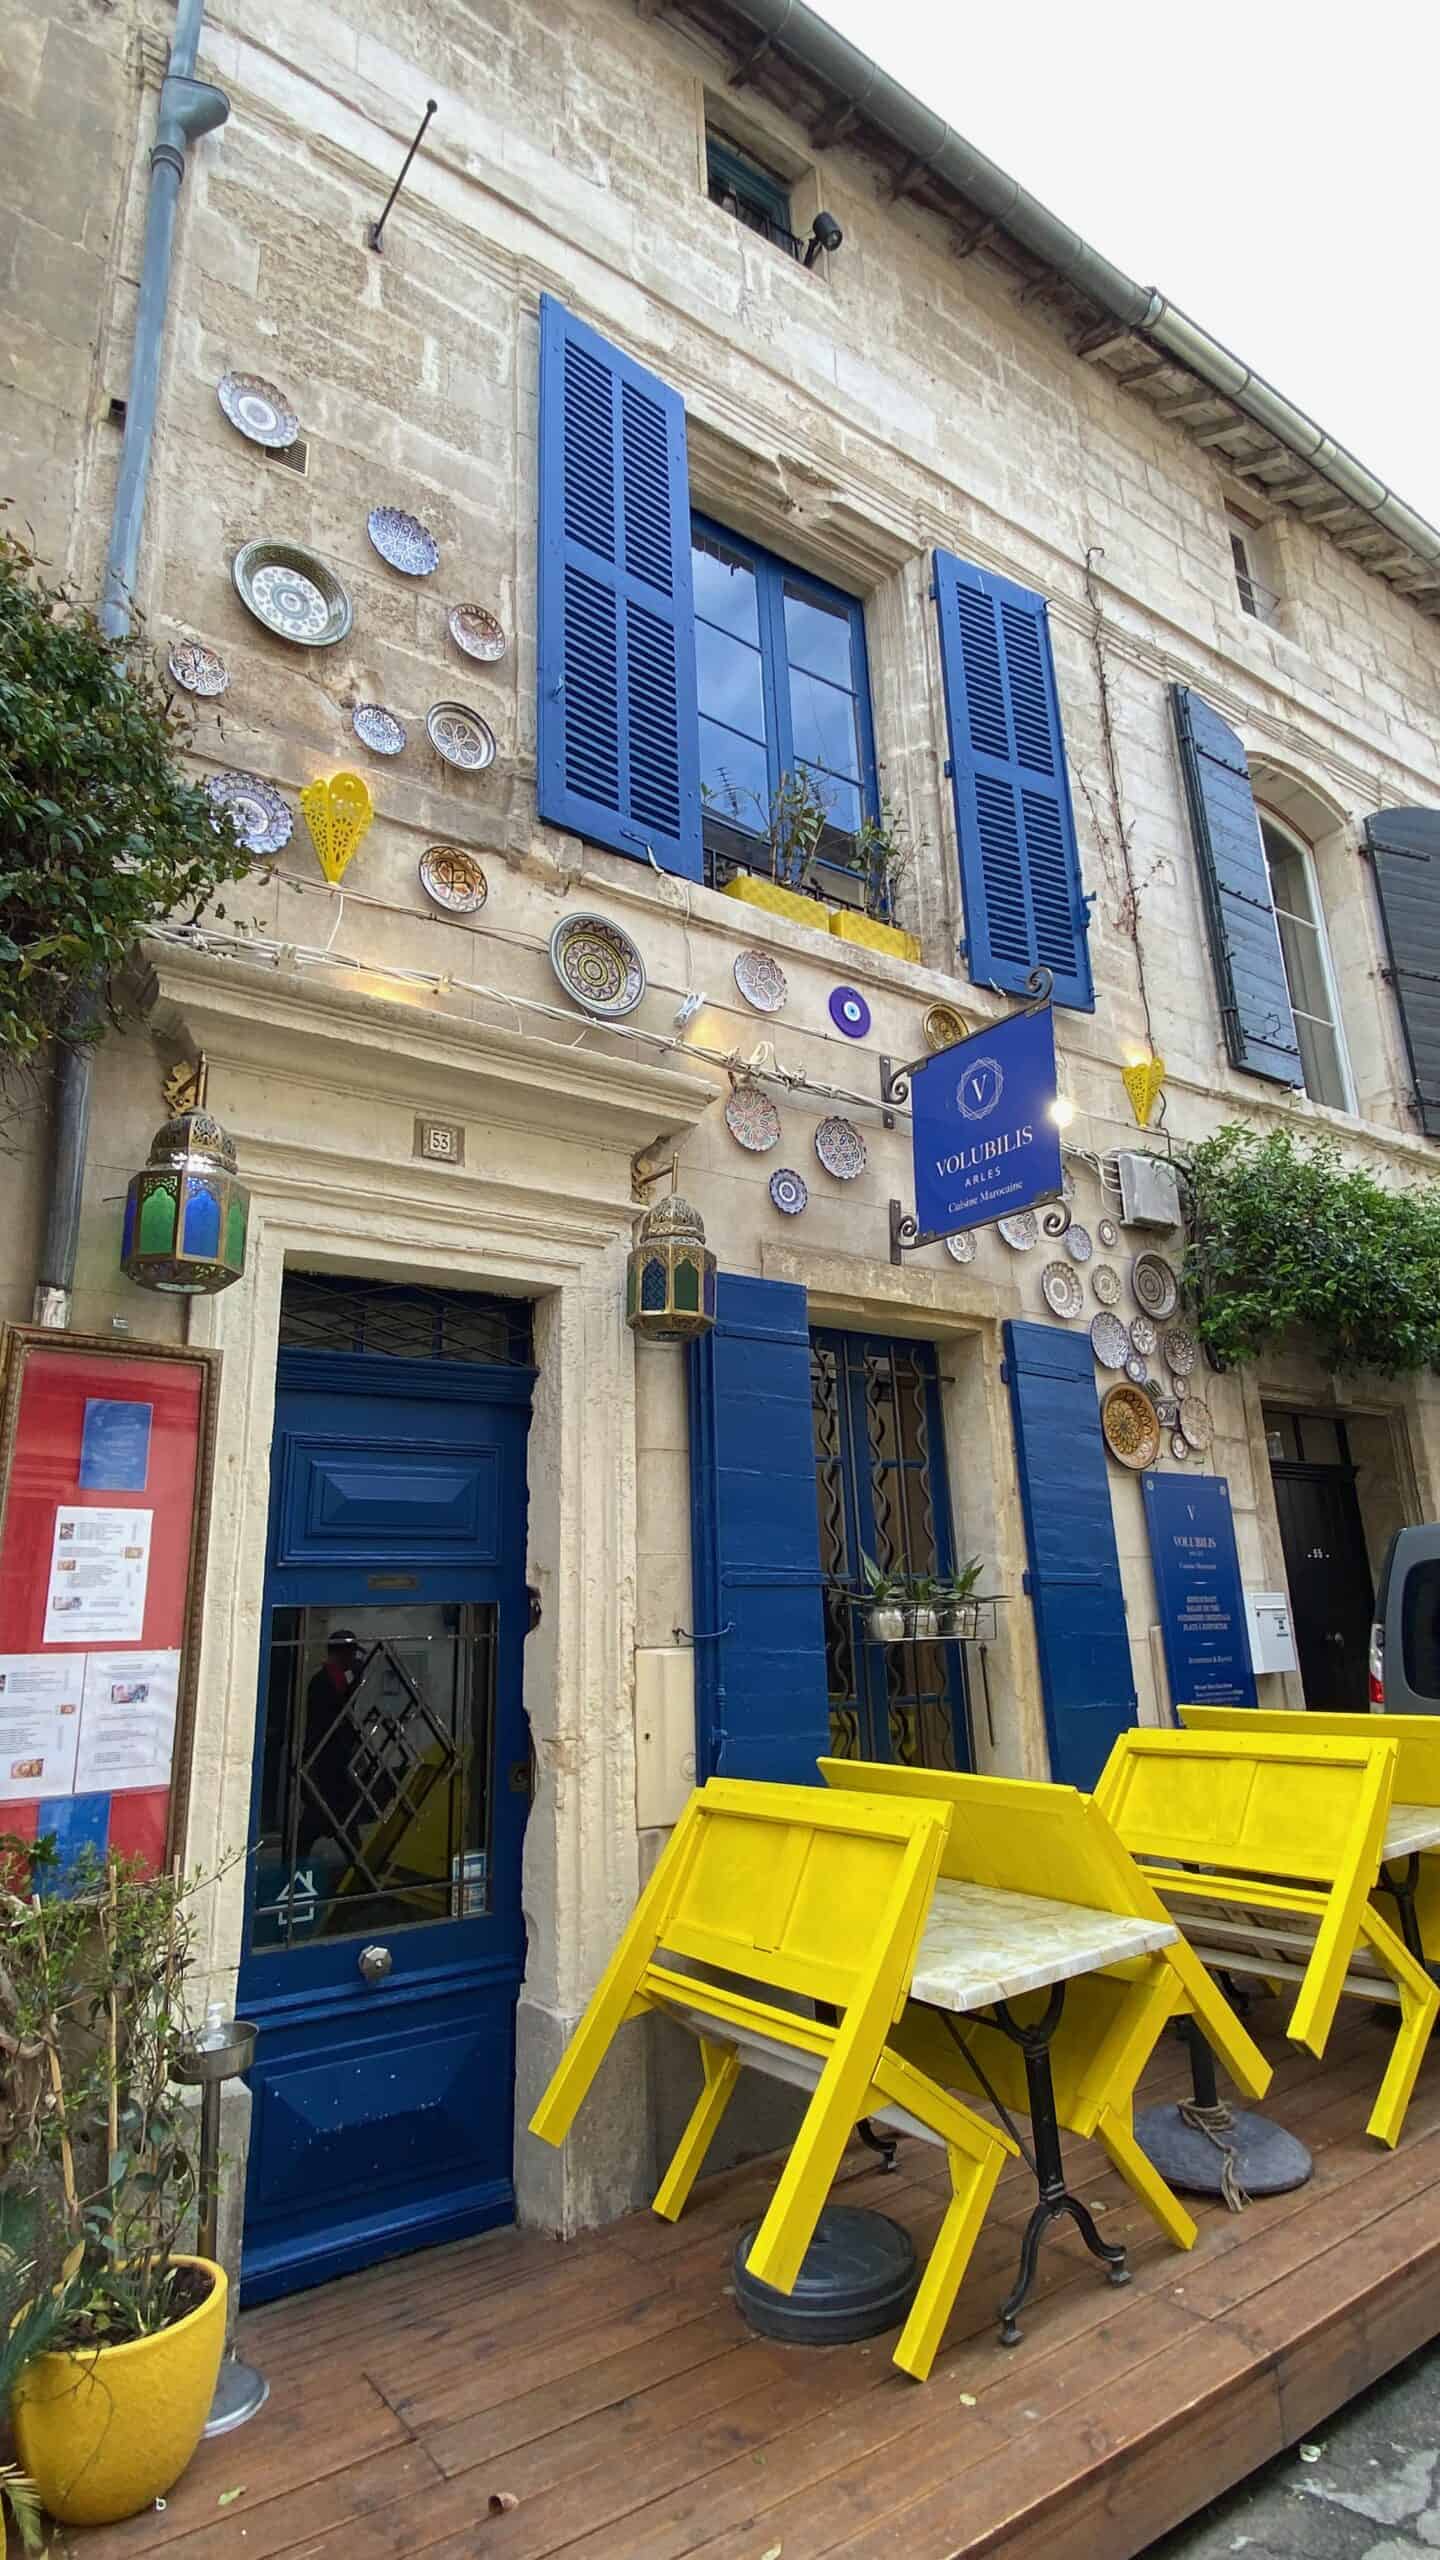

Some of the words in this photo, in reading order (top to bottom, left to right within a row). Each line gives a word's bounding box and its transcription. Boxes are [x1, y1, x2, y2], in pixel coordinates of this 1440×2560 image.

[972, 1074, 987, 1102] V
[433, 1132, 448, 1149] 53
[935, 1125, 1033, 1178] VOLUBILIS
[964, 1165, 1002, 1188] ARLES
[948, 1196, 978, 1214] Cuisine
[979, 1180, 1024, 1203] Marocaine
[1173, 1535, 1217, 1549] VOLUBILIS
